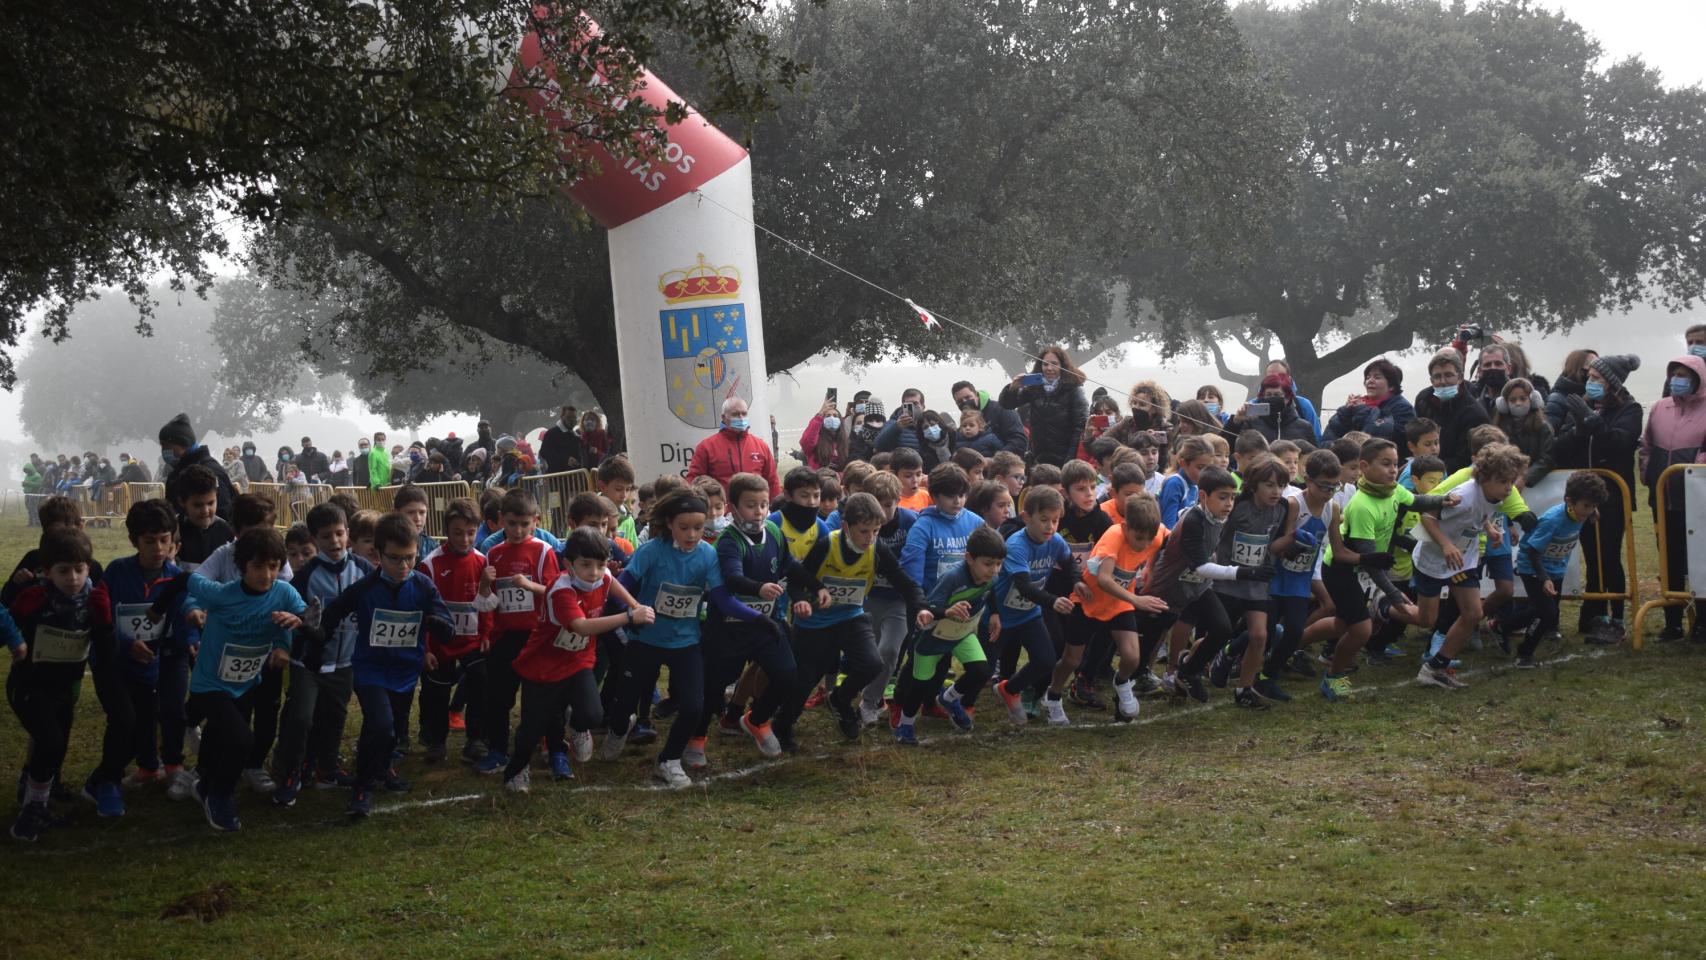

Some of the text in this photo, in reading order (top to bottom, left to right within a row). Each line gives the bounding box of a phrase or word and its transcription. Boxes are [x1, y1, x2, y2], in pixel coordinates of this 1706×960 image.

[933, 537, 944, 549] LA
[1236, 544, 1262, 557] 214
[501, 589, 526, 603] 113
[829, 586, 857, 597] 237
[664, 596, 693, 609] 359
[376, 623, 417, 638] 2164
[230, 658, 261, 673] 328
